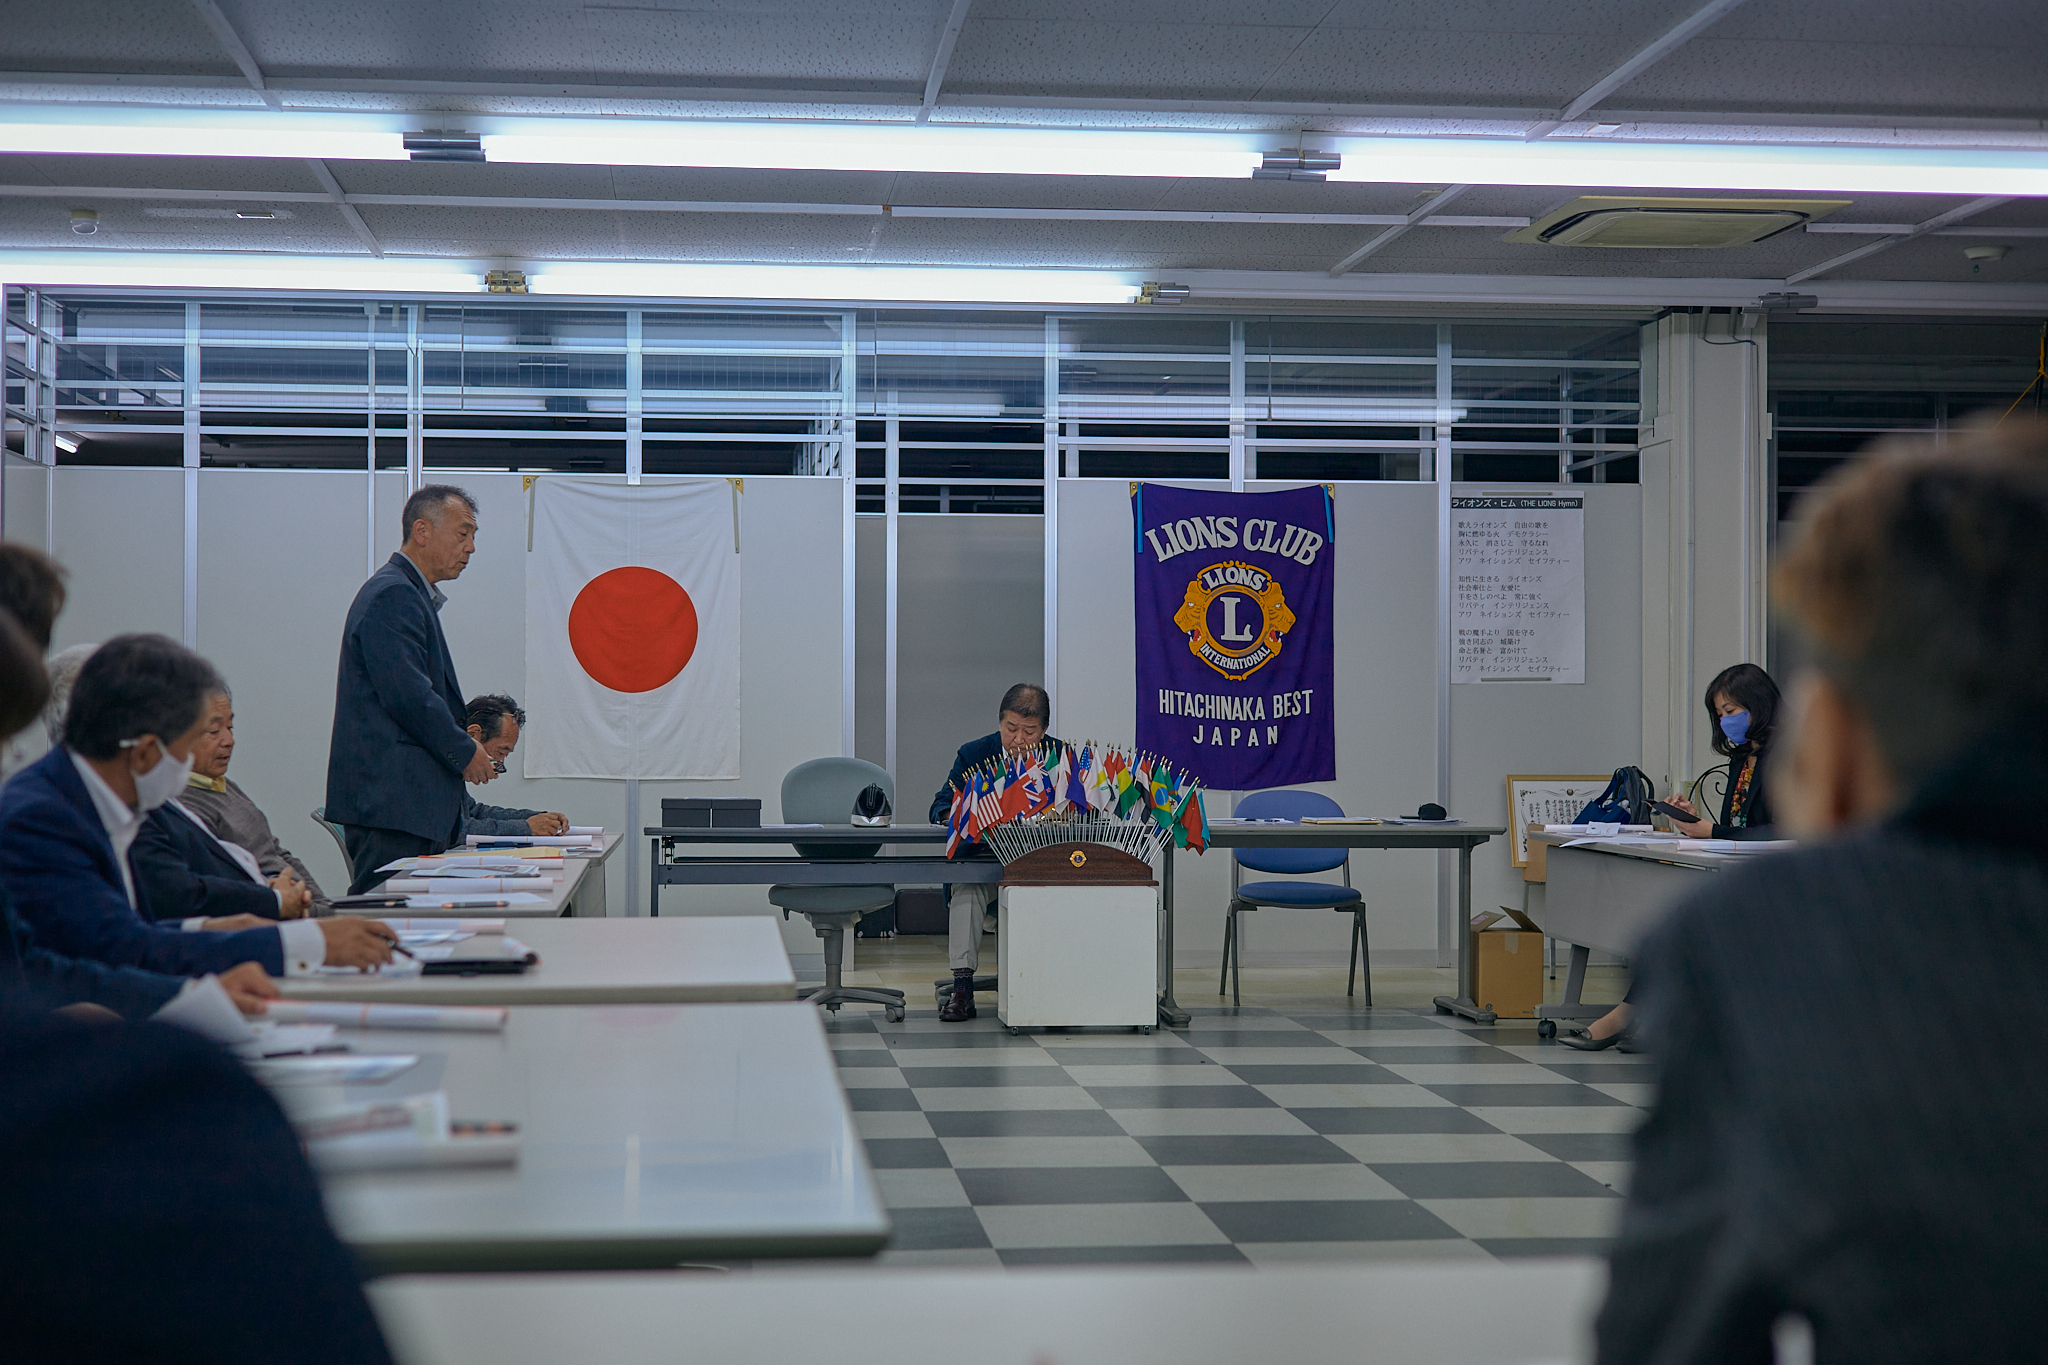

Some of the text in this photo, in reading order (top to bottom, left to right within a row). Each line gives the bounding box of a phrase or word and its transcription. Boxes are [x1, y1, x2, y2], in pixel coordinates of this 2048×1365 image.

[1537, 499, 1556, 507] LIONS
[1145, 516, 1323, 566] LIONS CLUB
[1203, 567, 1266, 591] LIONS
[1220, 596, 1253, 641] L
[1200, 643, 1271, 670] INTERNATIONAL
[1159, 689, 1313, 721] HITACHINAKA BEST
[1193, 725, 1278, 747] JAPAN
